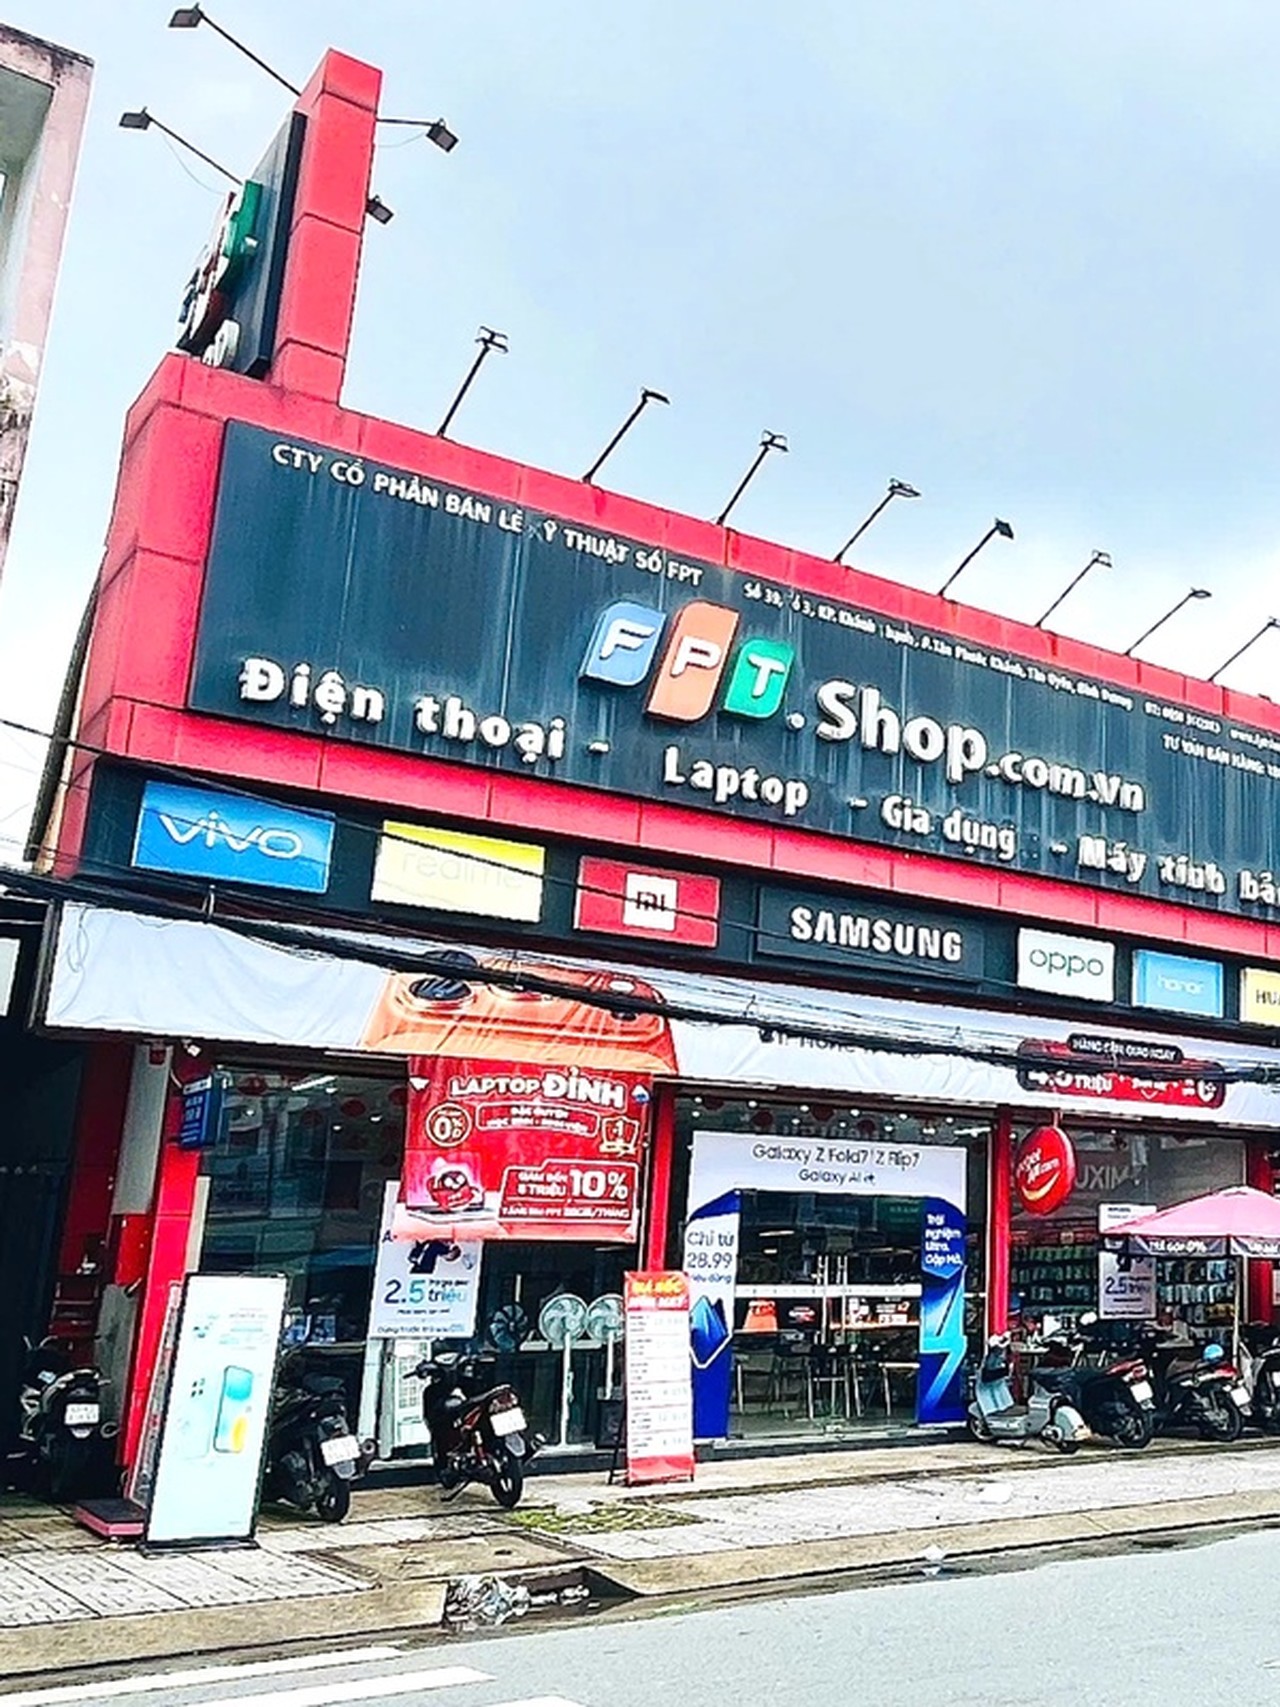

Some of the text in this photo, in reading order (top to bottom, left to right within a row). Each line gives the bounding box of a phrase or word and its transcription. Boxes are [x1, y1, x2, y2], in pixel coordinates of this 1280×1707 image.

[272, 444, 323, 473] CTY
[330, 460, 366, 486] CỔ
[373, 472, 438, 508] PHẦN
[445, 493, 491, 524] BÁN
[499, 506, 524, 533] LẺ
[564, 526, 628, 564] THUẬT
[636, 551, 662, 573] SỐ
[668, 561, 702, 586] FPT
[588, 605, 793, 712] FPT
[238, 654, 386, 724] Điện
[413, 690, 566, 764] thoại
[662, 746, 809, 816] Laptop
[881, 794, 930, 835] Gia
[943, 810, 1017, 860] dụng
[1079, 837, 1148, 882] Máy
[1161, 858, 1227, 896] tính
[159, 810, 303, 860] vivo
[402, 852, 523, 889] realme
[790, 906, 963, 962] SAMSUNG
[451, 1066, 625, 1109] LAPTOP ĐỈNH
[752, 1143, 920, 1171] Galaxy Z Fold7 Z Flip7
[569, 1169, 628, 1199] 10%
[799, 1168, 846, 1186] Galaxy
[687, 1229, 715, 1246] Chỉ
[687, 1252, 732, 1269] 28.99
[384, 1279, 425, 1304] 2.5
